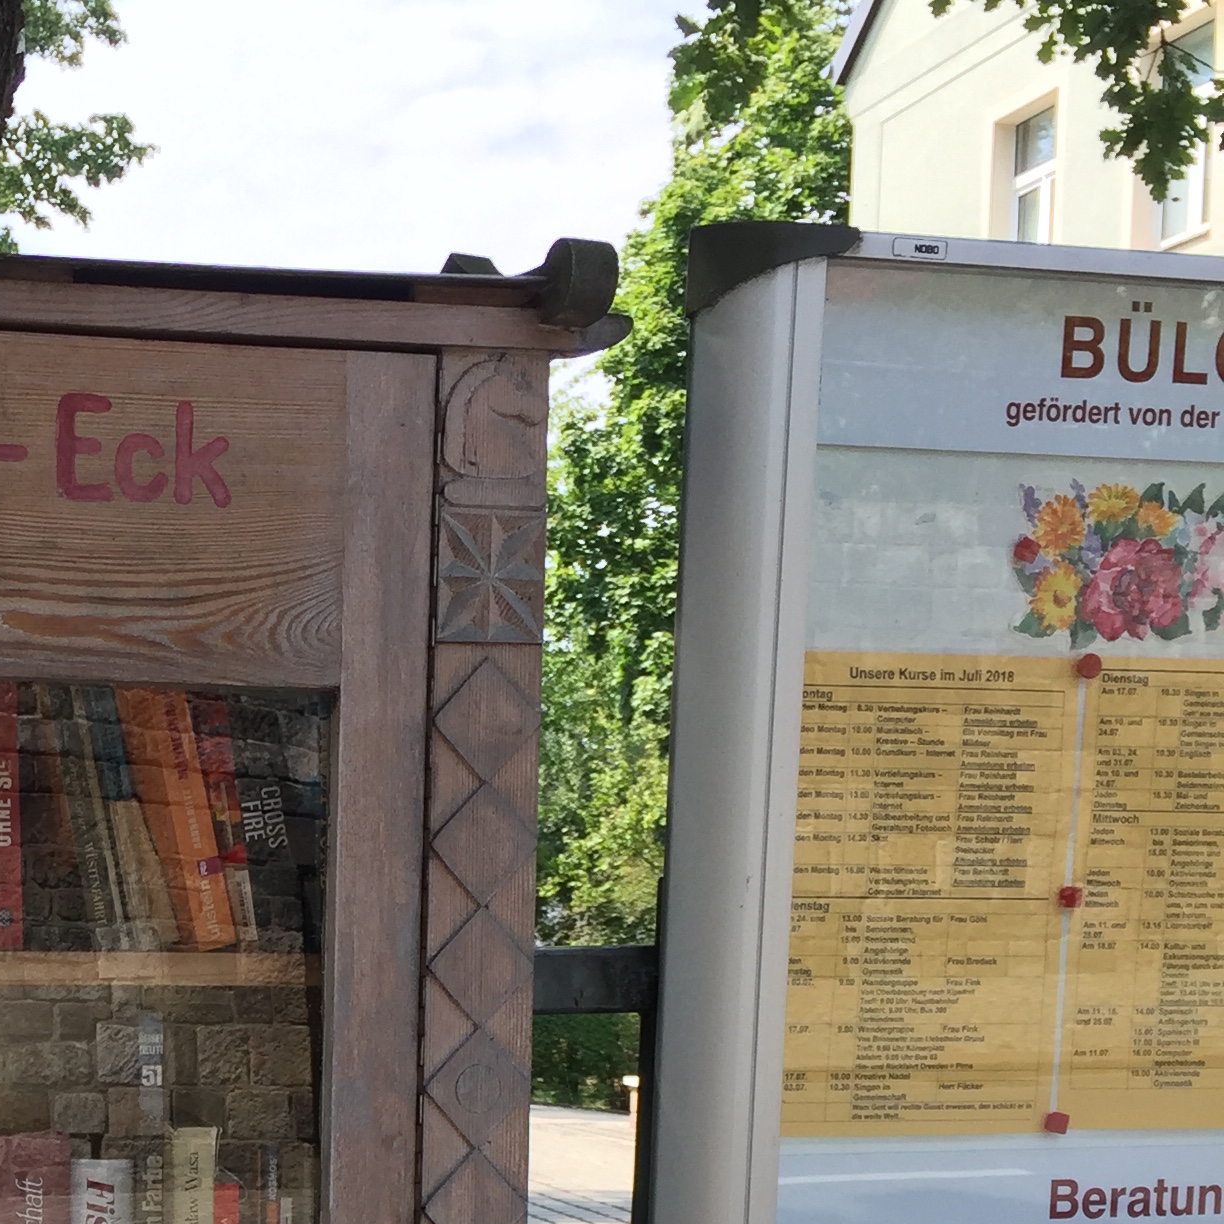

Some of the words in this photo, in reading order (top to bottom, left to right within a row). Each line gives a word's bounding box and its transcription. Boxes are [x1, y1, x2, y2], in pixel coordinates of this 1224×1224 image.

[914, 243, 939, 256] NOBO
[1060, 300, 1224, 388] BÜL
[1006, 398, 1121, 428] gefördert
[1129, 406, 1171, 428] von
[1180, 405, 1220, 429] der
[56, 392, 231, 509] Eck
[850, 667, 895, 680] Unsere
[899, 668, 936, 681] Kurse
[940, 668, 955, 681] im
[959, 669, 982, 683] Juli
[984, 670, 1014, 683] 2018
[1102, 673, 1149, 687] Dienstag
[240, 799, 266, 843] FIRE
[260, 785, 289, 849] CROSS
[1092, 813, 1140, 825] Mittwoch
[141, 1064, 163, 1087] 51
[184, 1151, 199, 1192] Wasa
[1049, 1179, 1222, 1221] Beratun
